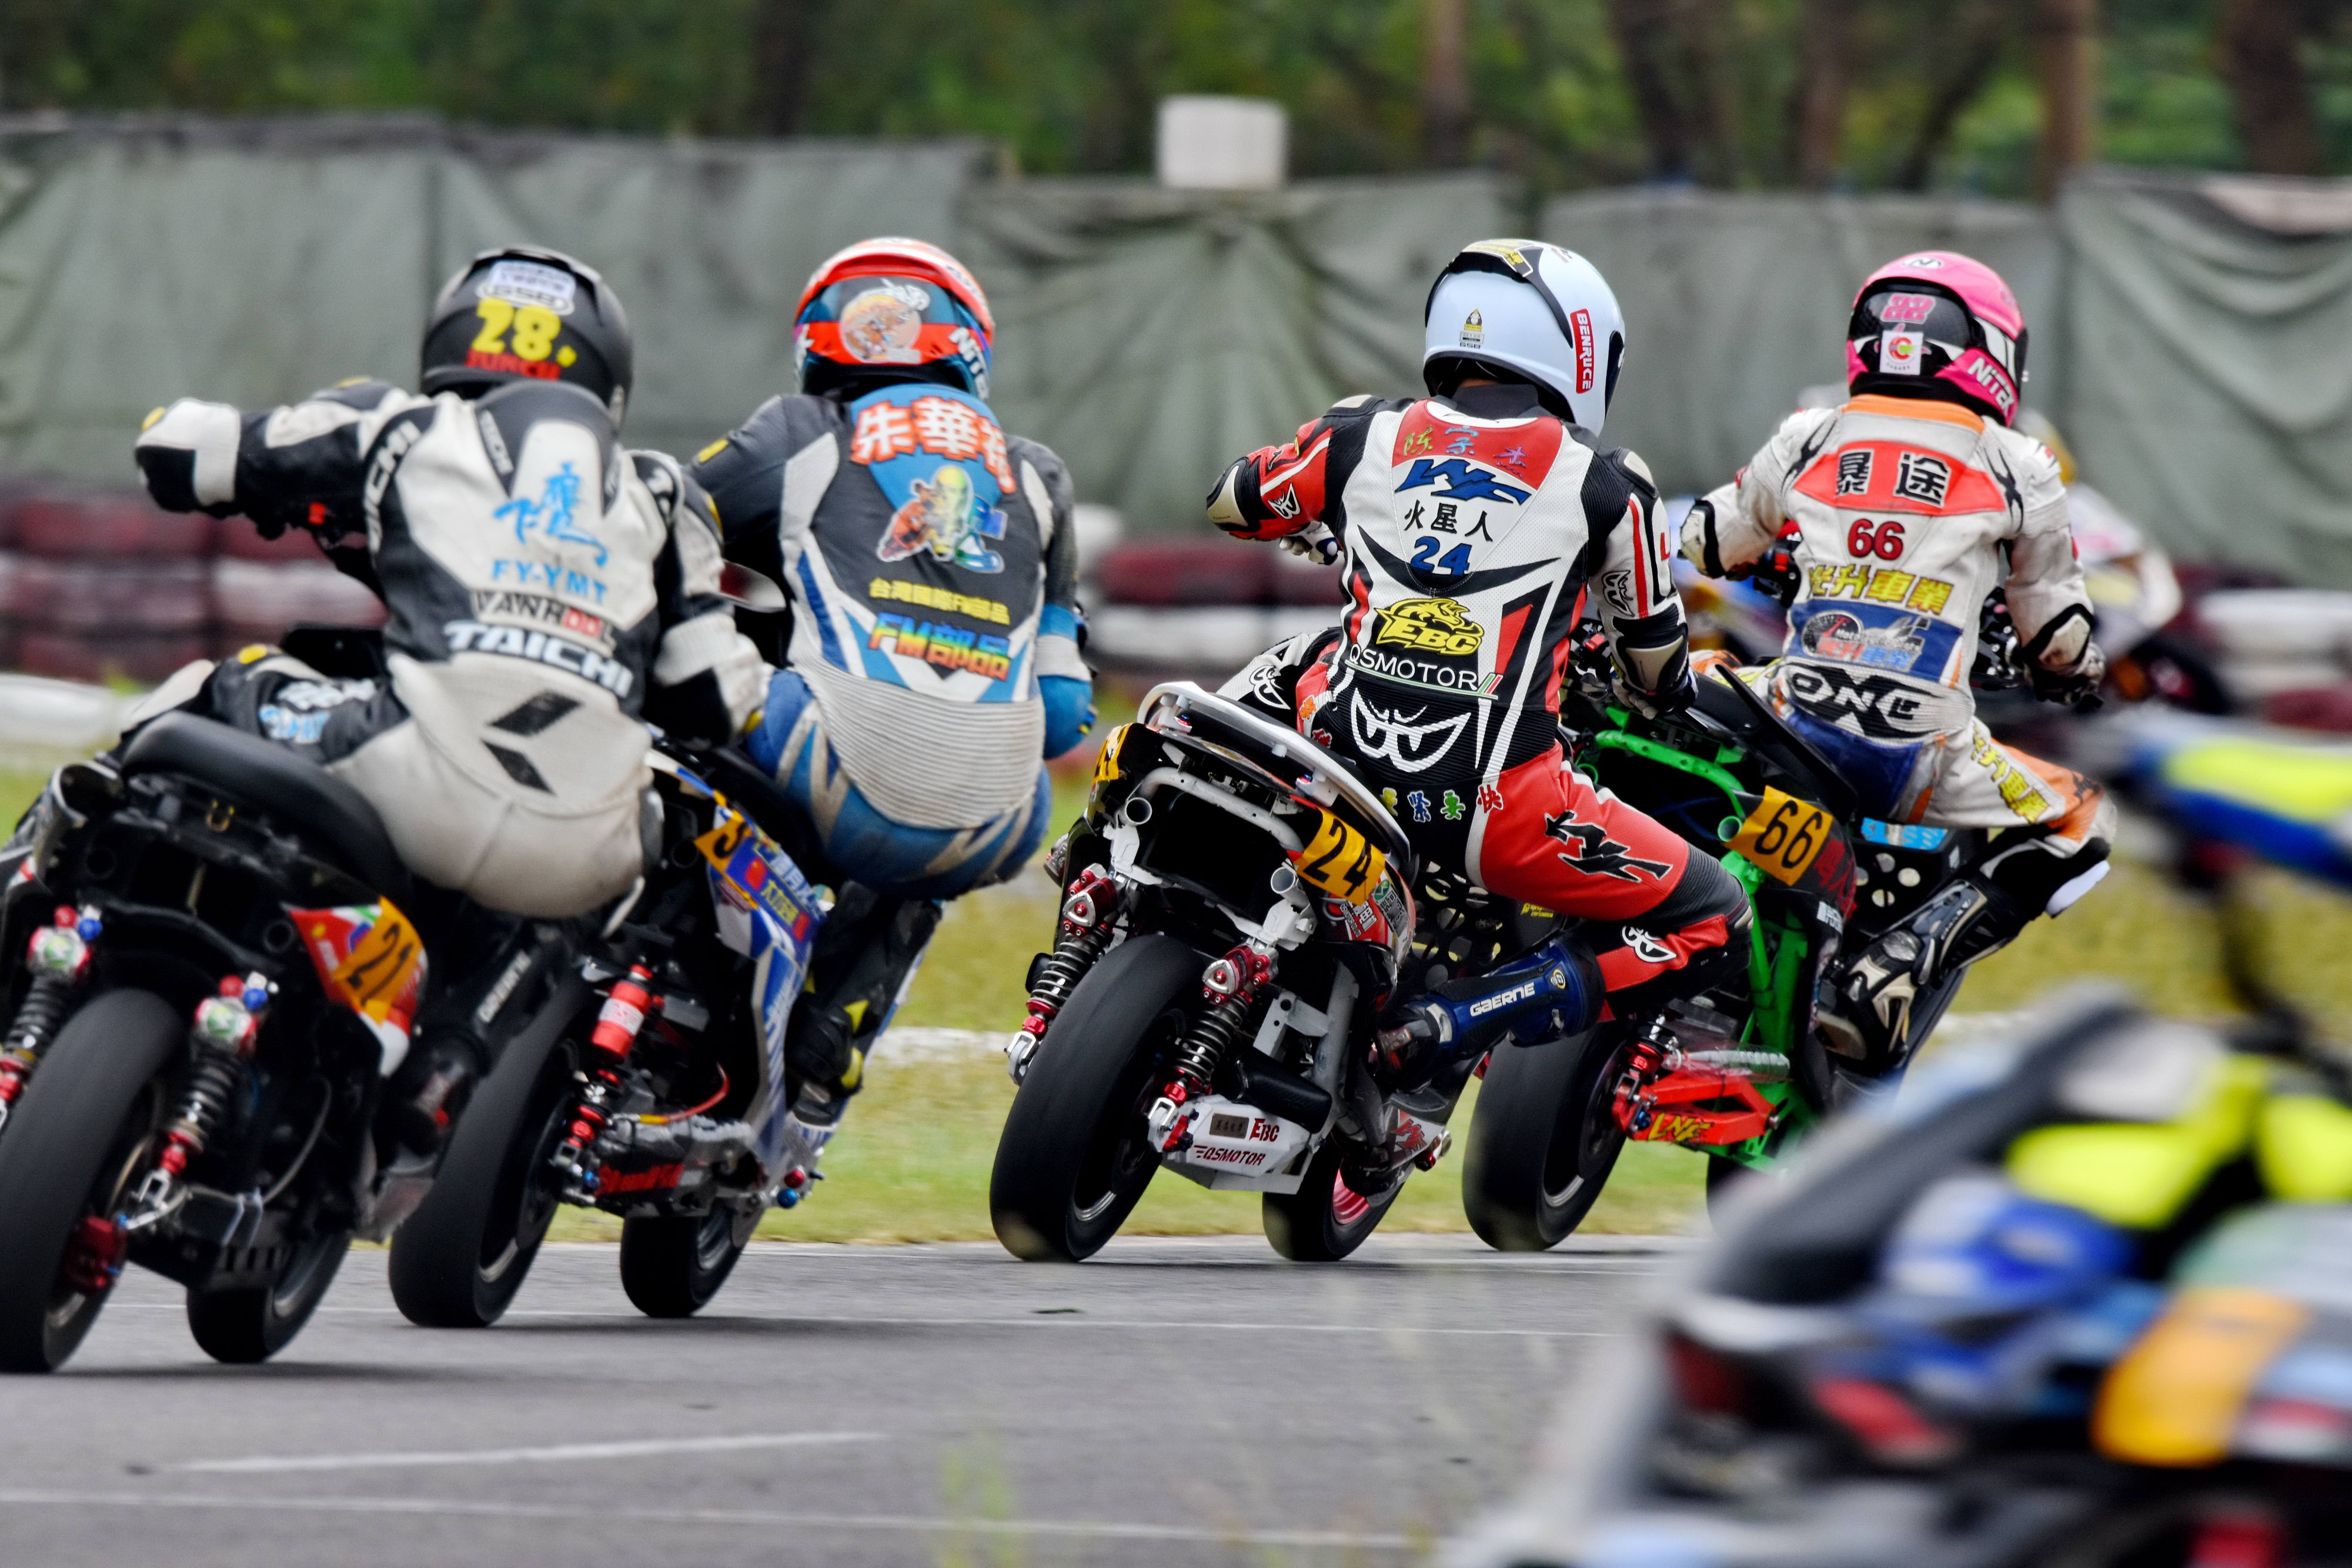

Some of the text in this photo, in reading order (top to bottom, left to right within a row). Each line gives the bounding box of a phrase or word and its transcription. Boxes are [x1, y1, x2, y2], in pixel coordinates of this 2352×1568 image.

[1576, 312, 1593, 390] BENRUCE
[1404, 500, 1494, 543] 火星人
[1847, 518, 1905, 560] 66
[1410, 536, 1473, 576] 24
[492, 560, 607, 604] FY-YMT
[1383, 615, 1482, 655] EBC
[444, 619, 633, 698] TAICHI
[1349, 644, 1478, 691] QSMOTOR
[1754, 800, 1822, 869] 66
[1303, 818, 1372, 897] 24
[1250, 1118, 1279, 1142] EBC
[1203, 1147, 1266, 1166] QSMOTOR
